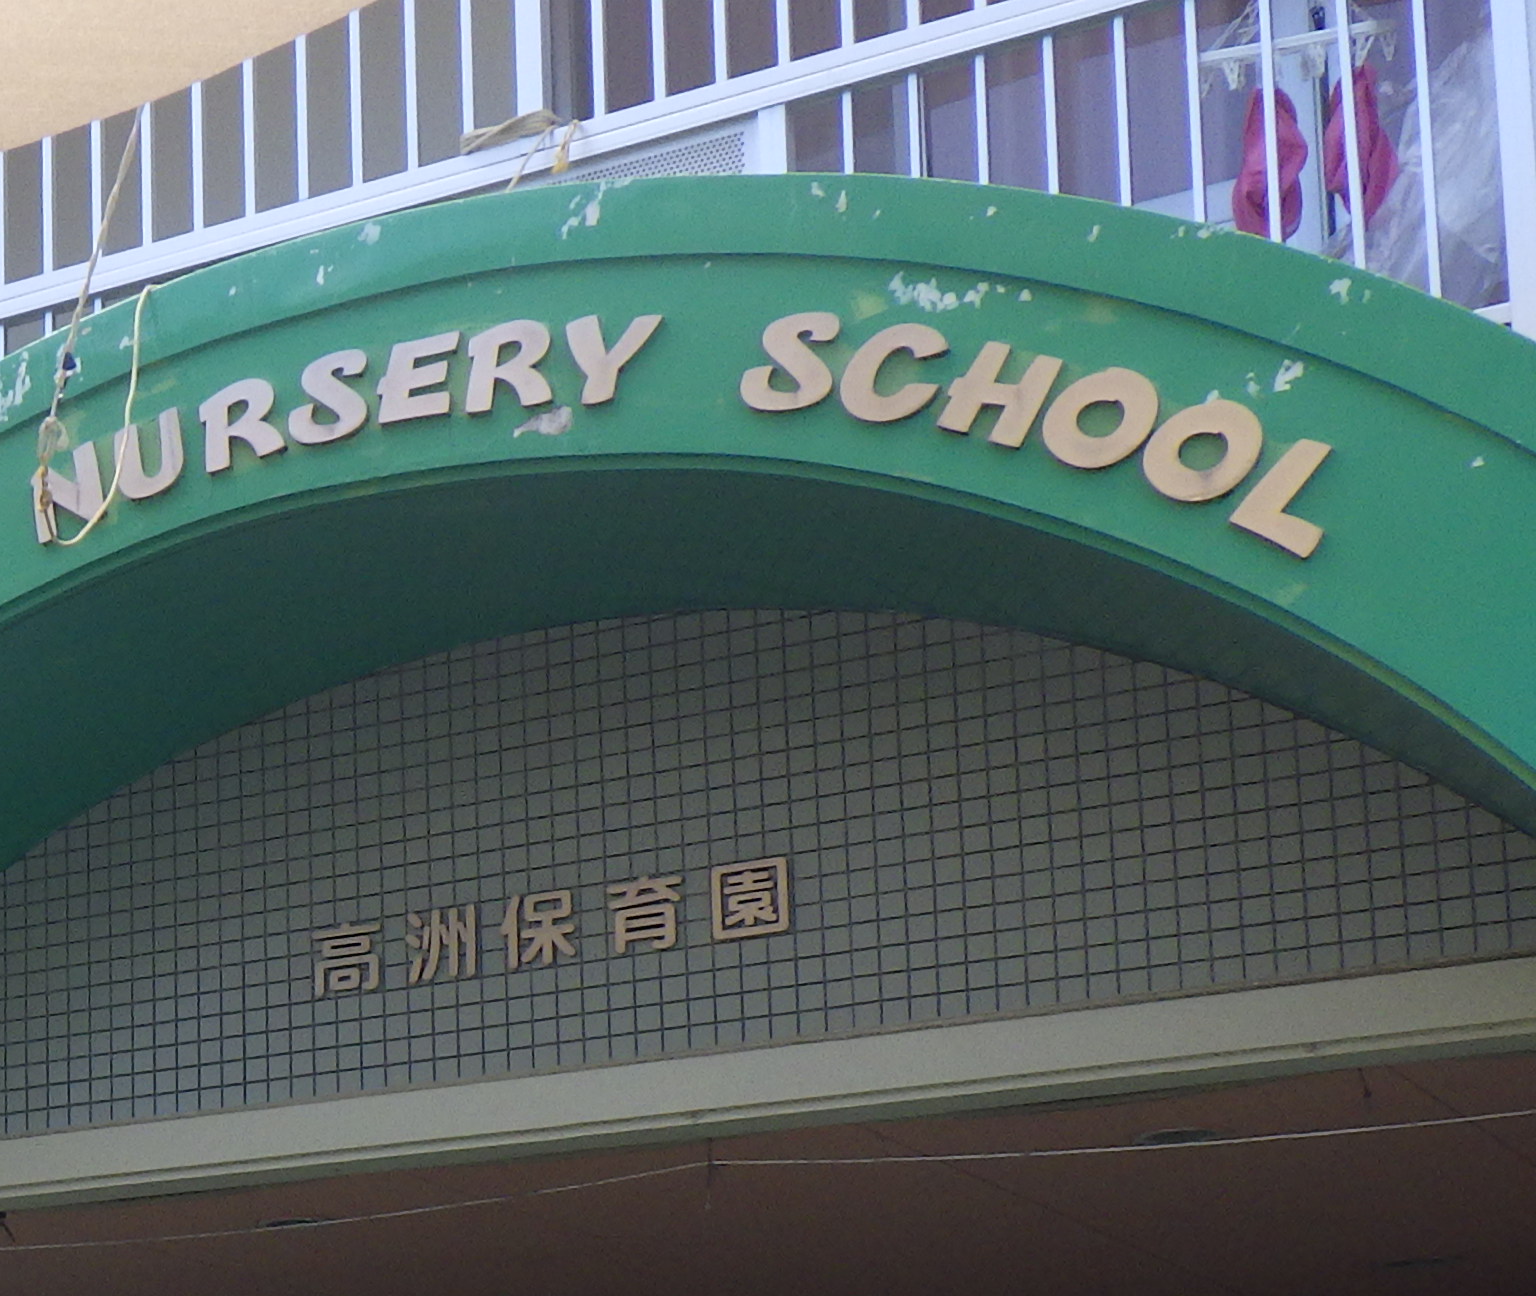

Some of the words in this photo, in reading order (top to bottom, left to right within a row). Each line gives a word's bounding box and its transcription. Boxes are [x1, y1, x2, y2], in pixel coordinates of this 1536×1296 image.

[31, 314, 663, 545] NURSERY
[740, 312, 1332, 558] SCHOOL
[311, 857, 790, 999] 高洲保育園
